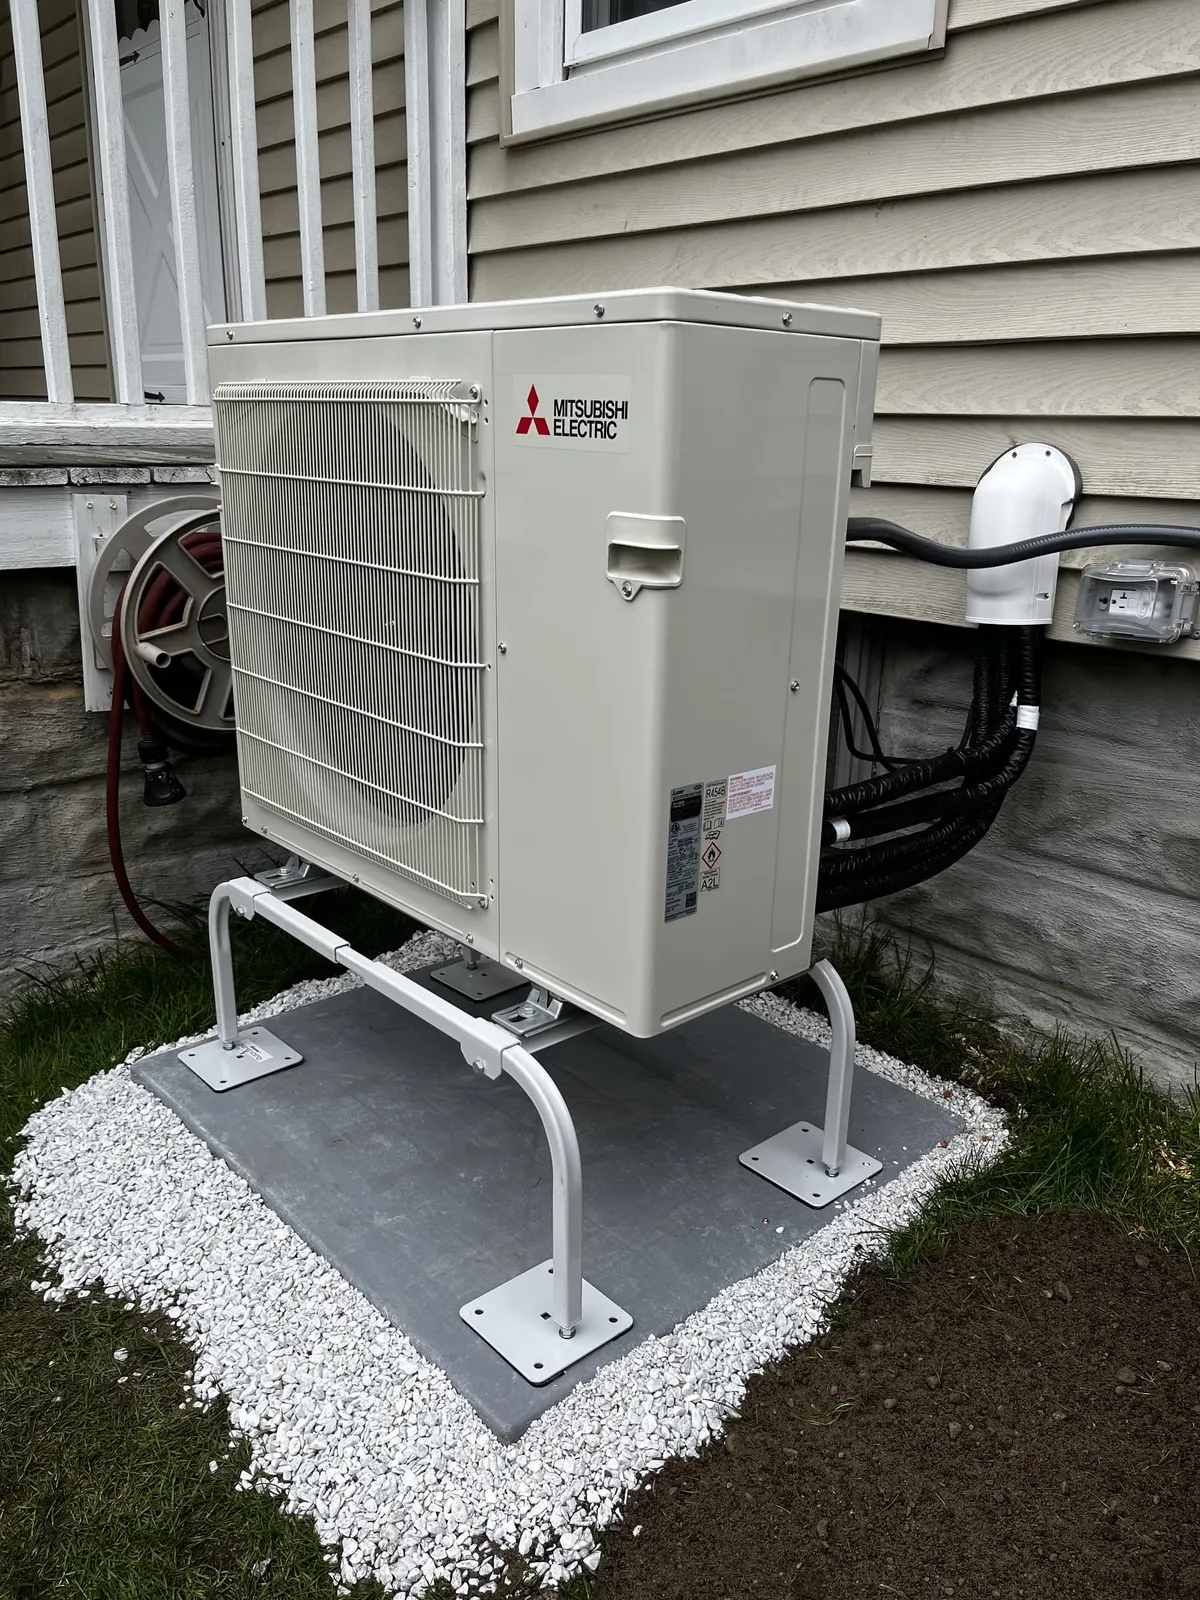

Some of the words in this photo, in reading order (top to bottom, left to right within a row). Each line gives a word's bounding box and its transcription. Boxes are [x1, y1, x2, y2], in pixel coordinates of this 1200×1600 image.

[553, 399, 628, 420] MITSUBISHI
[553, 418, 617, 440] ELECTRIC
[706, 785, 726, 798] R454B
[701, 877, 719, 890] A2L
